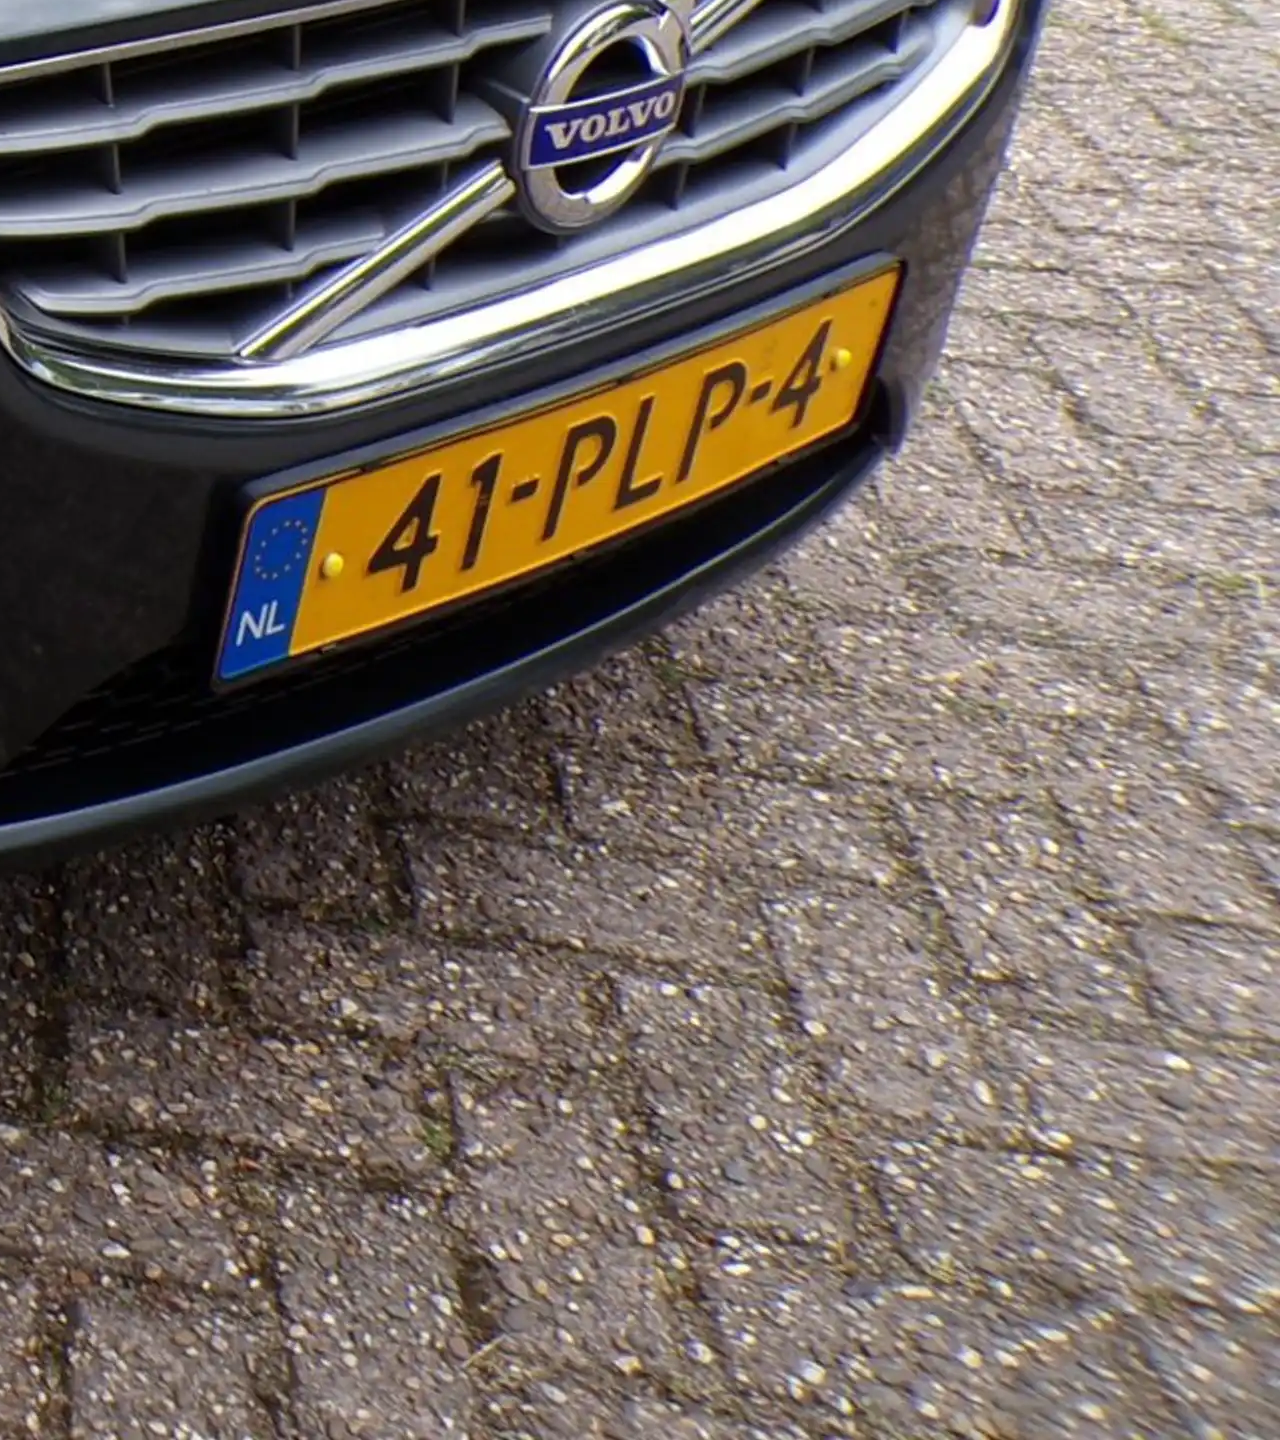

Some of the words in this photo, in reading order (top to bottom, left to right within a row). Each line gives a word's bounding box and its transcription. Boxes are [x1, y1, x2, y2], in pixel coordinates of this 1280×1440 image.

[544, 91, 676, 150] VOLVO
[367, 317, 834, 593] 41-PLP-4
[235, 601, 286, 647] NL
